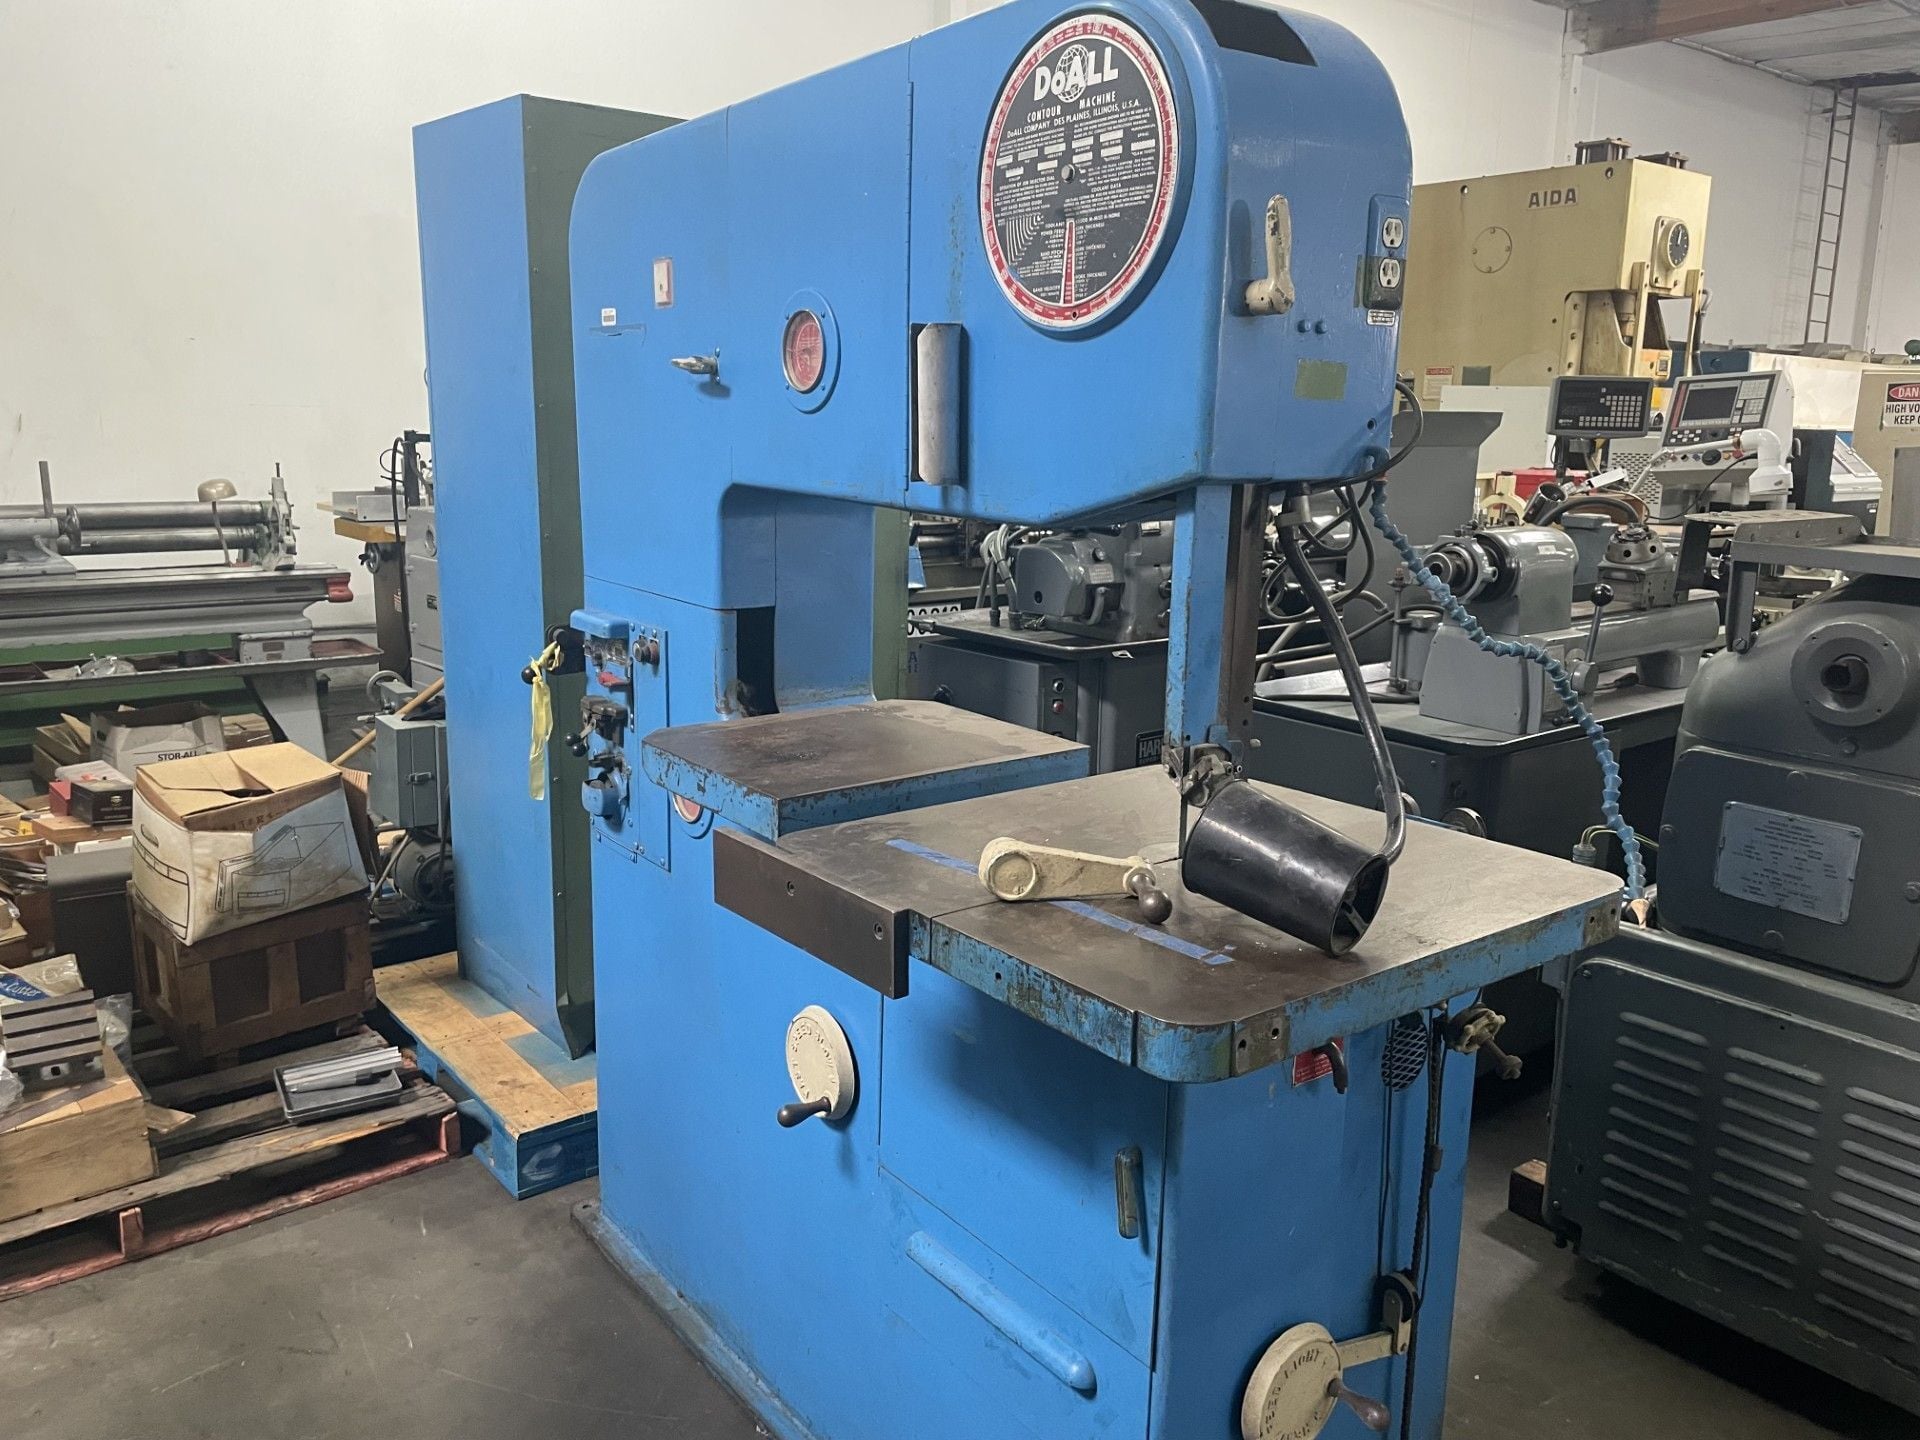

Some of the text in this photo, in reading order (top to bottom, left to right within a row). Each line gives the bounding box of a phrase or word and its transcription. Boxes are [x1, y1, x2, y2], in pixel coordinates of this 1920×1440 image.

[1033, 46, 1119, 101] DoALL
[1027, 105, 1062, 123] CONTOUR
[1079, 91, 1116, 110] MACHINE
[1023, 121, 1050, 134] COMPANY
[1053, 117, 1066, 127] DES
[1528, 188, 1577, 209] AIDA
[1886, 404, 1907, 413] HIGH
[1894, 415, 1915, 425] KEEP
